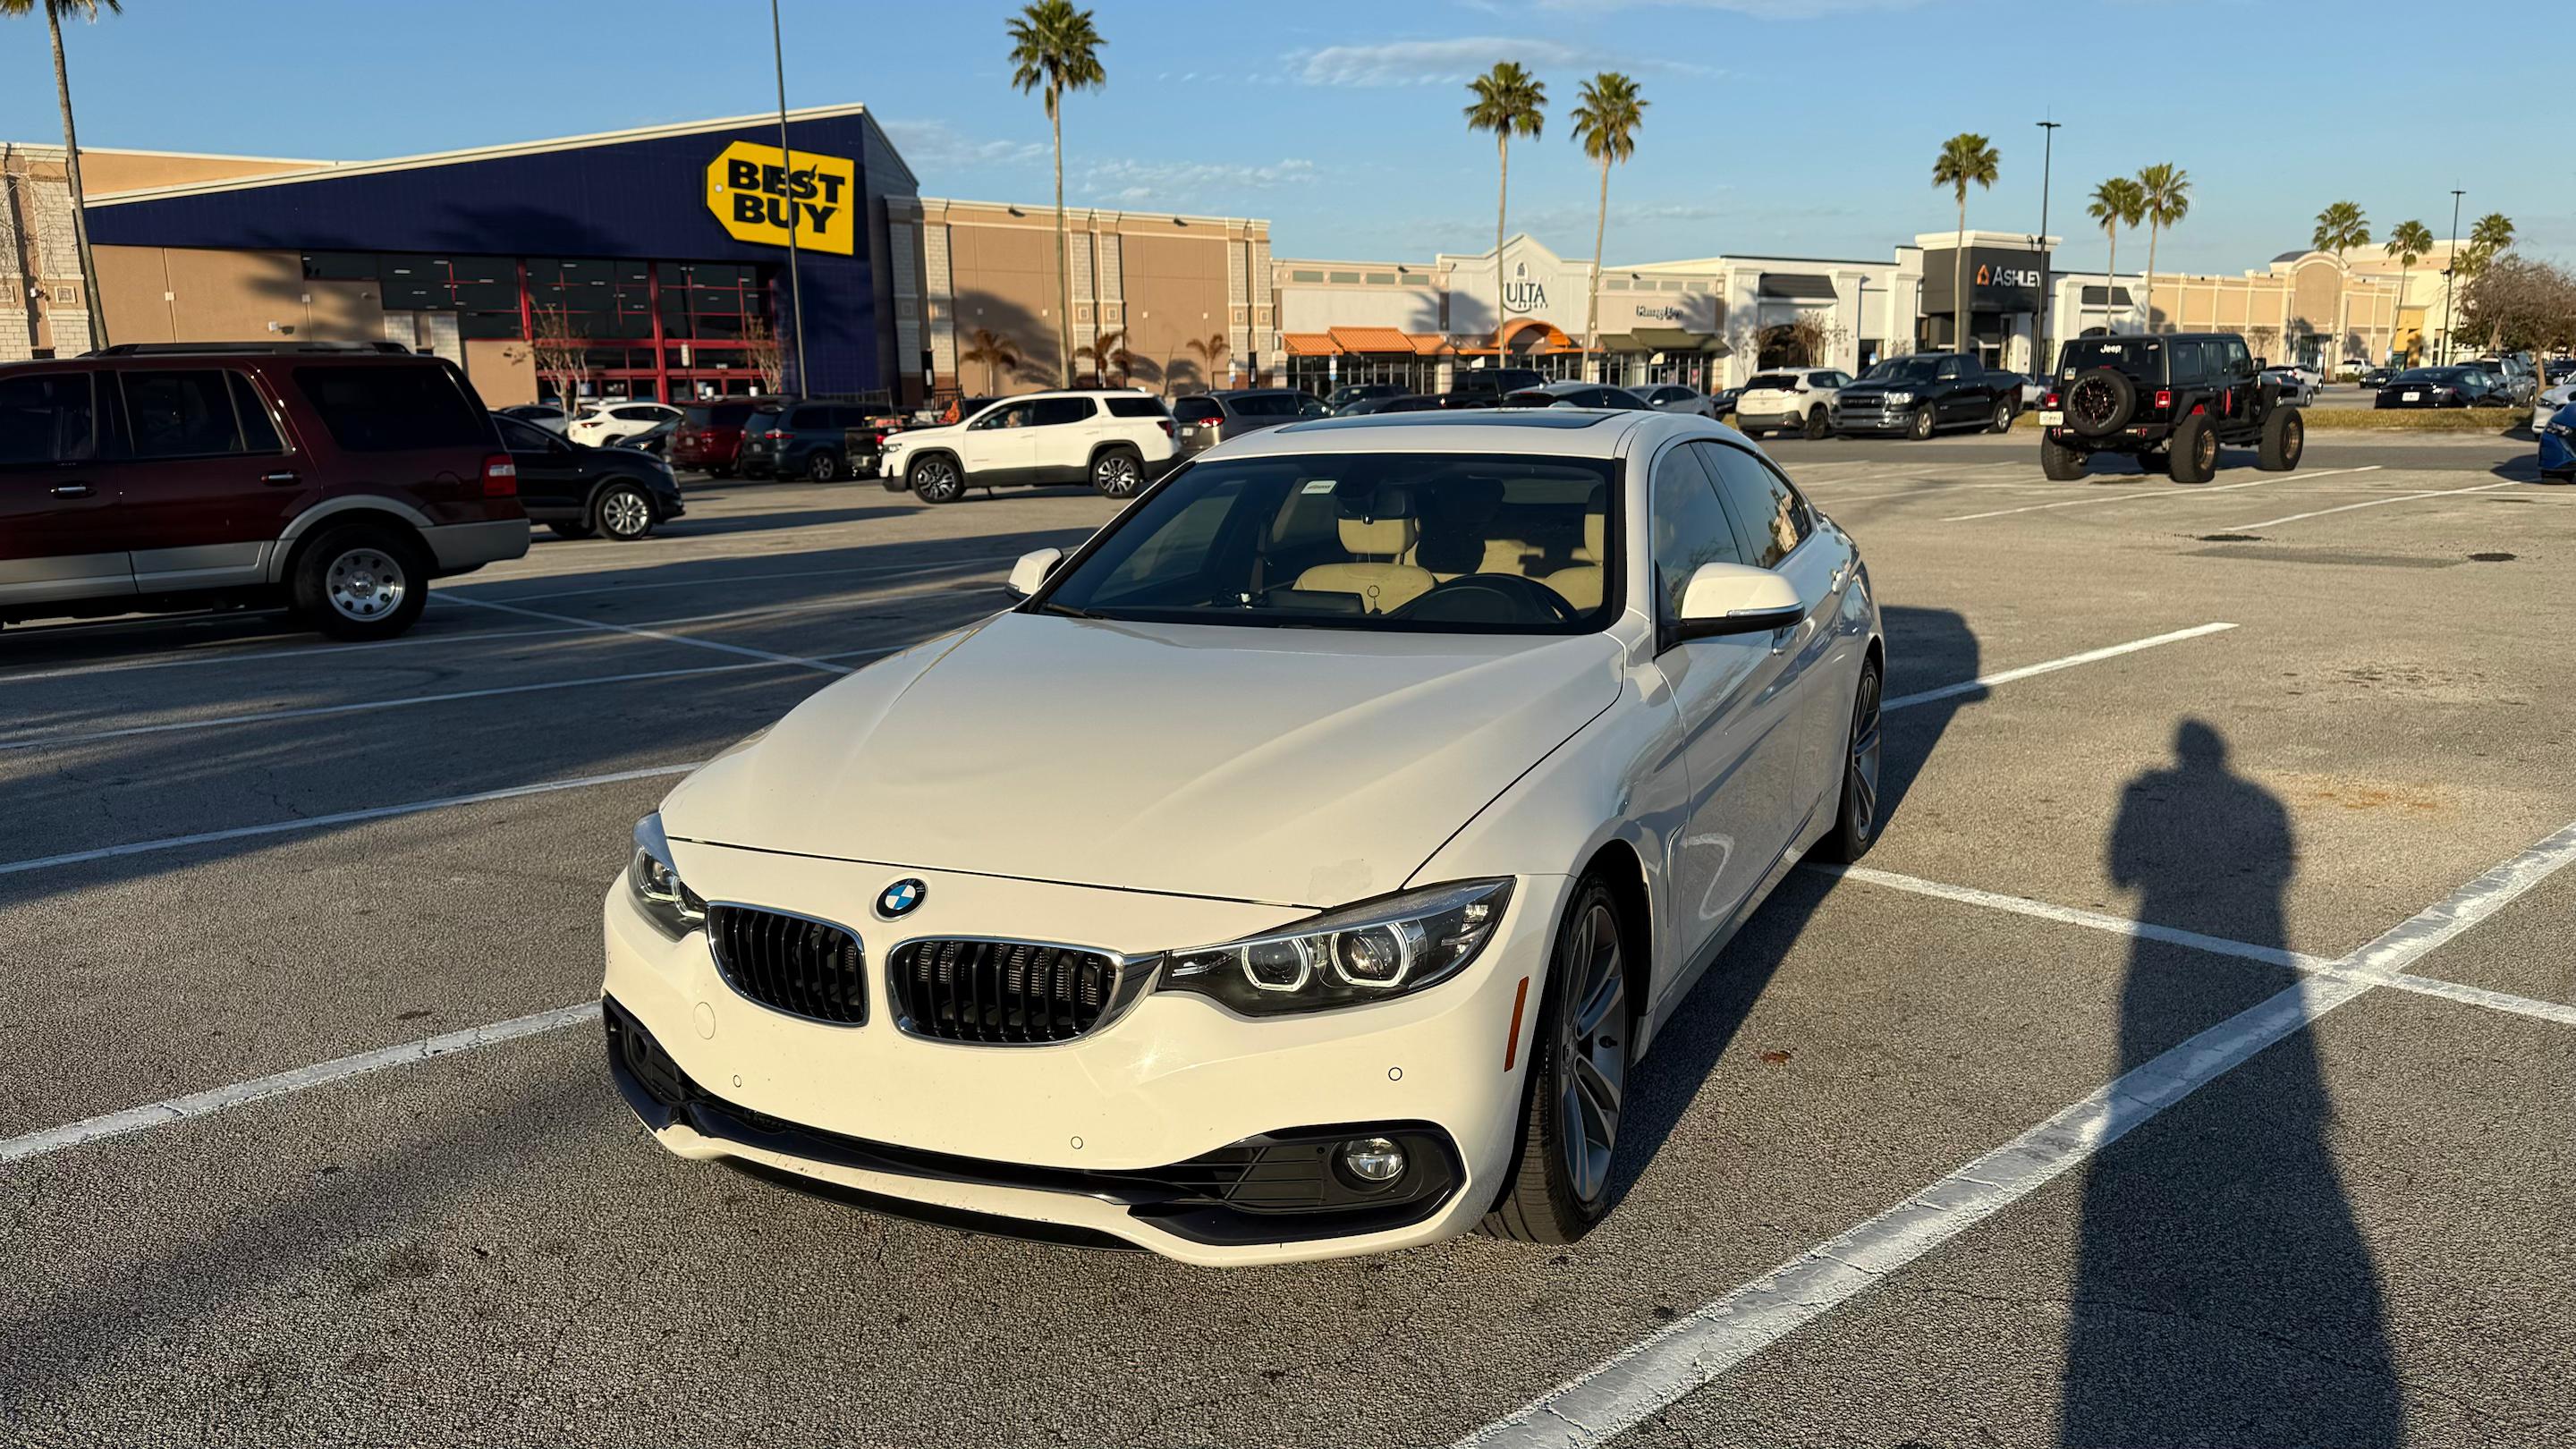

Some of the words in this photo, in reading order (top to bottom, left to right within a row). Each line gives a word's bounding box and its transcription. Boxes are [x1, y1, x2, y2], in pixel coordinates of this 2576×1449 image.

[728, 158, 844, 203] BEST
[733, 192, 837, 233] BUY
[1506, 282, 1546, 303] ULTA
[2099, 343, 2122, 354] Jeep
